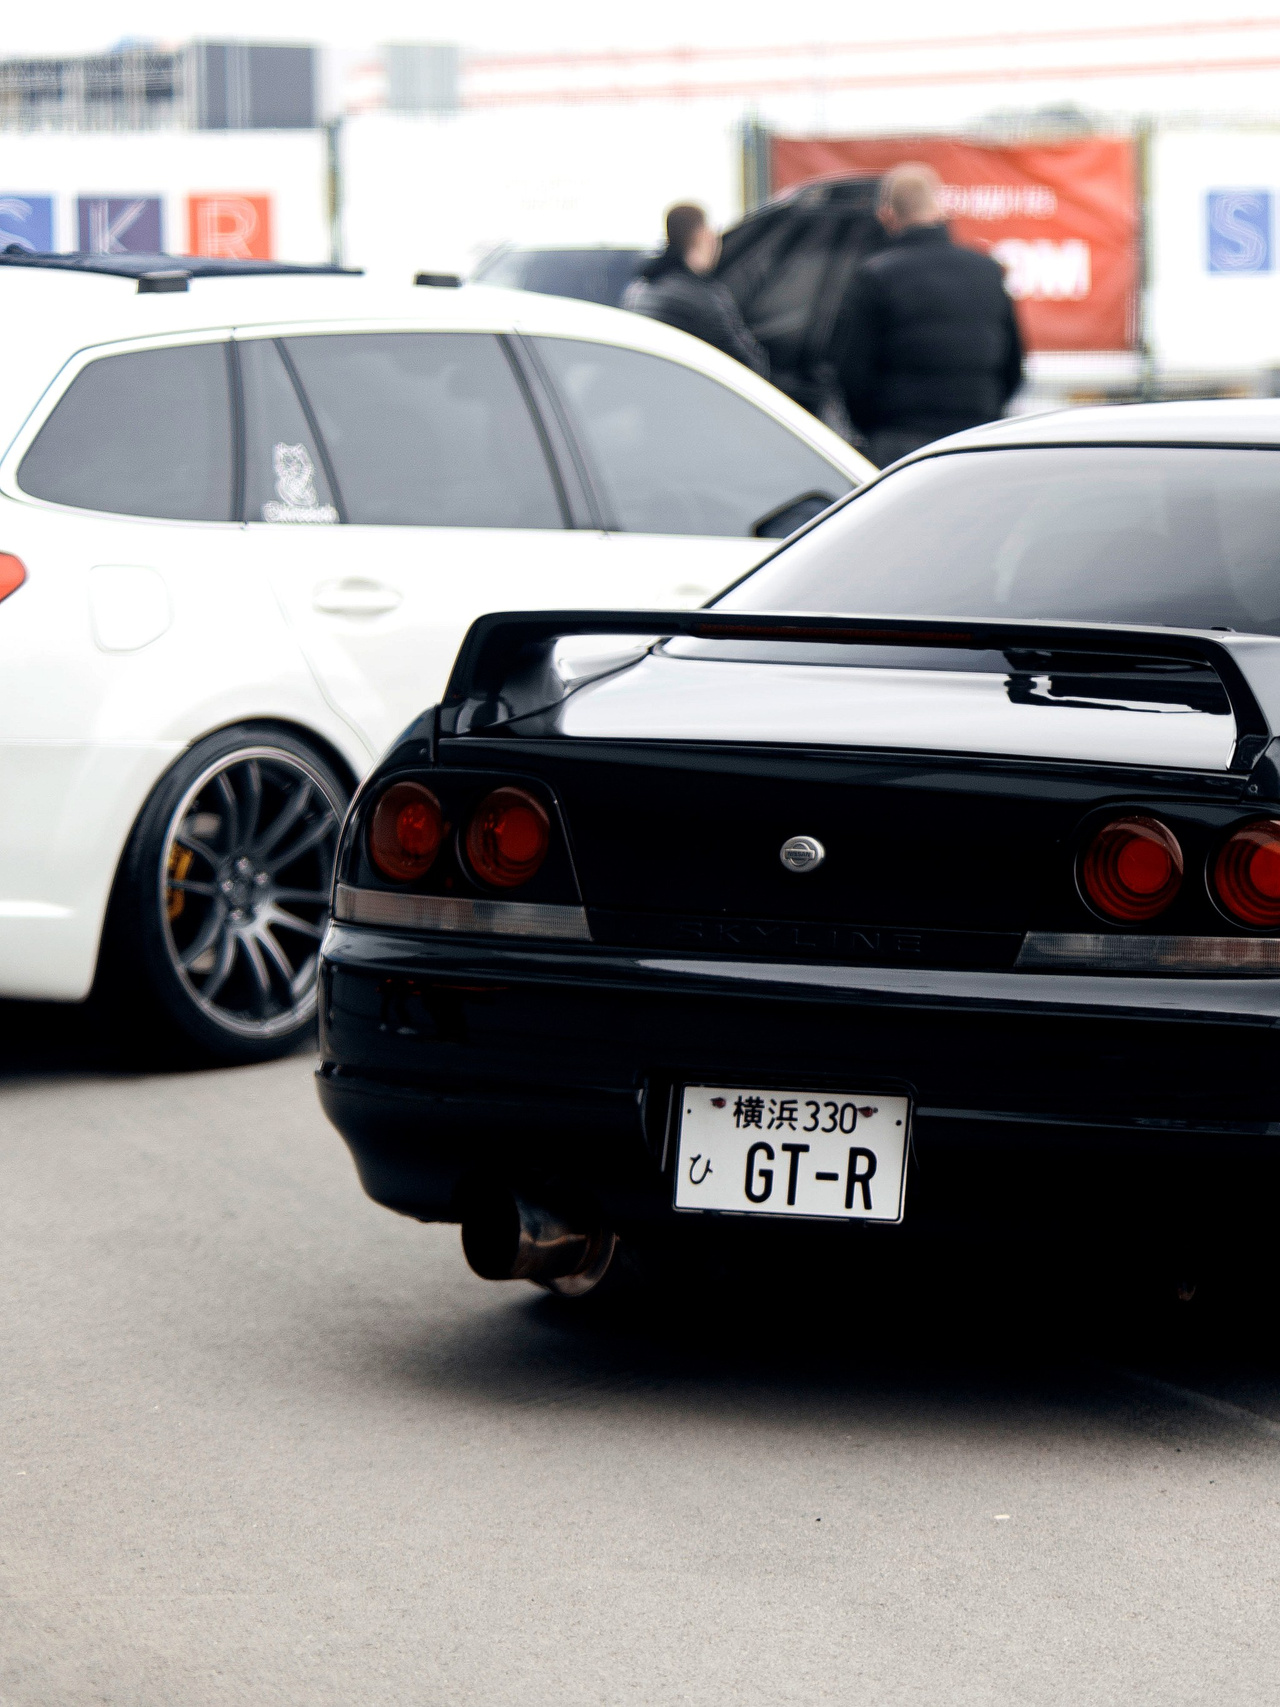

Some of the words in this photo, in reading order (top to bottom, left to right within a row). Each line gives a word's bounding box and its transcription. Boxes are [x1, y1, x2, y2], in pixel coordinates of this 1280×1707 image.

[676, 921, 922, 953] SKYLINE
[689, 1153, 713, 1185] ひ
[744, 1141, 877, 1210] GT-R
